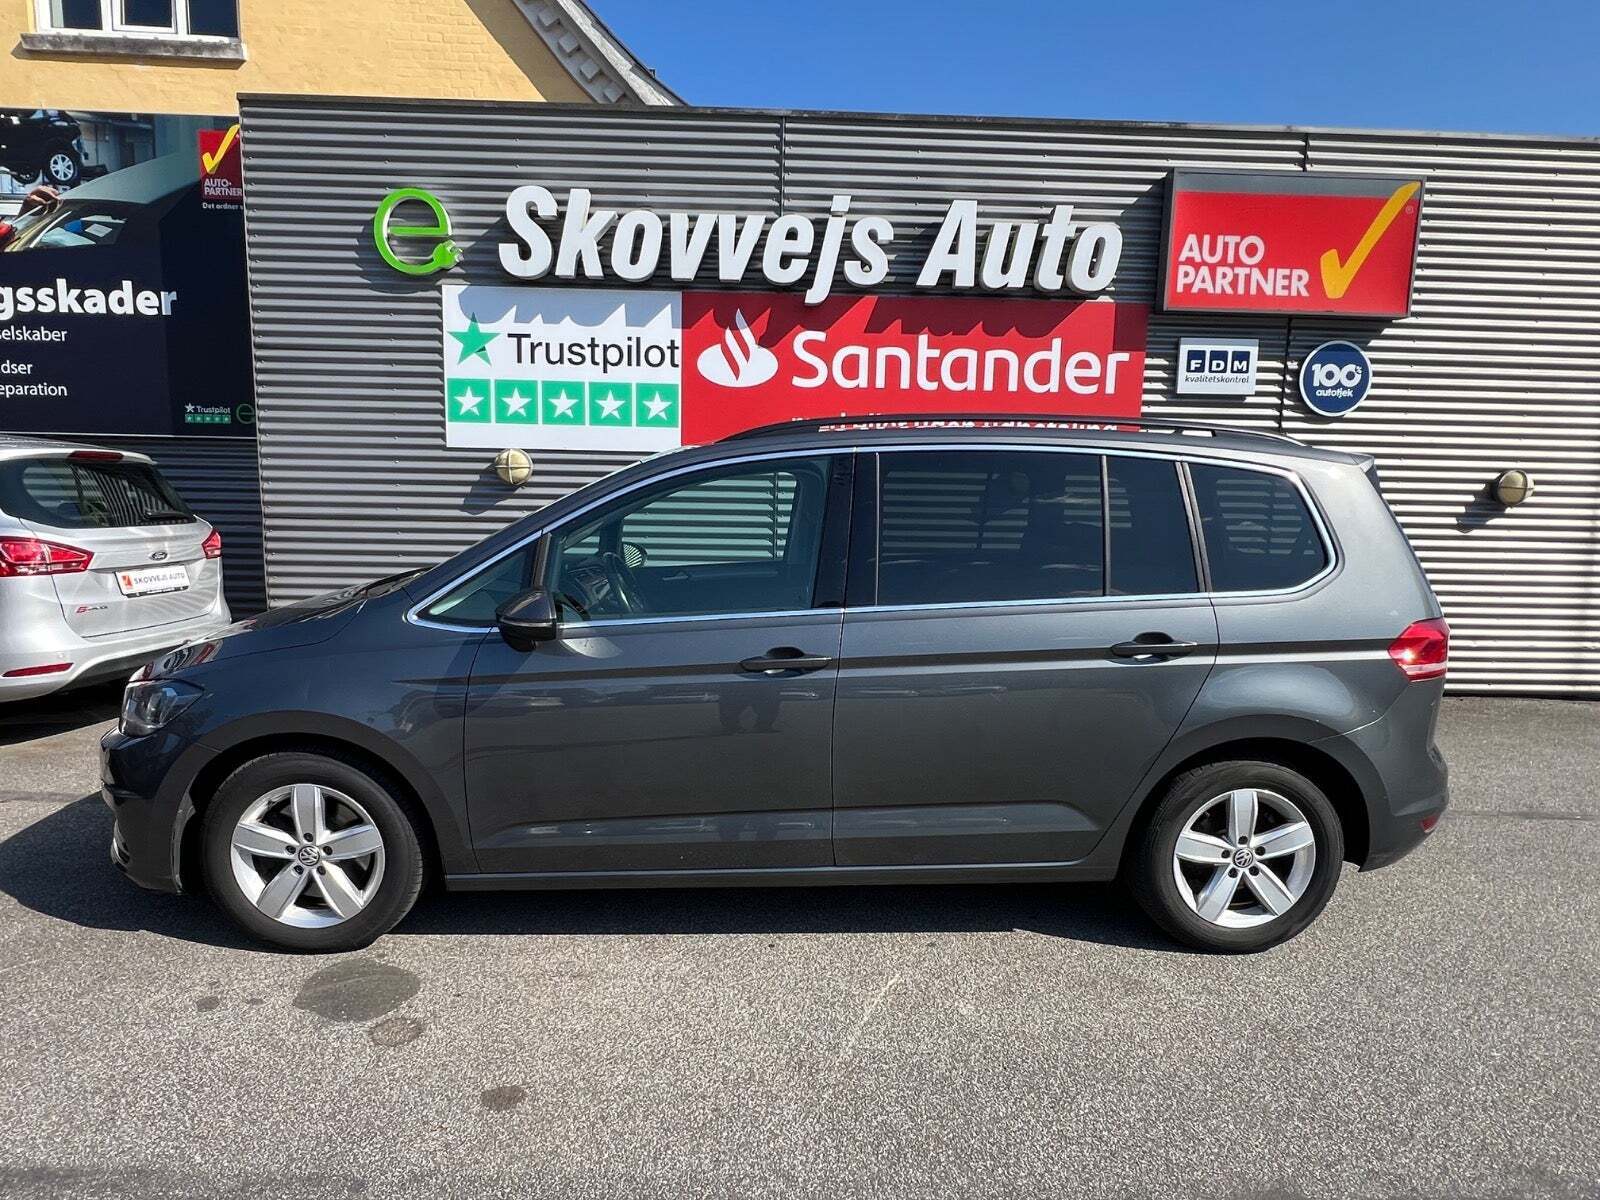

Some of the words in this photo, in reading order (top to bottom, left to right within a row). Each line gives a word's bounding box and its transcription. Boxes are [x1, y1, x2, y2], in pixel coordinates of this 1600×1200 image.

[204, 187, 243, 197] PARTNER
[498, 185, 895, 307] Skovvejs
[914, 199, 1123, 292] Auto
[1178, 233, 1266, 265] AUTO
[1176, 265, 1311, 298] PARTNER
[507, 333, 680, 374] Trustpilot
[792, 329, 1130, 395] Santander
[1184, 374, 1249, 384] kvalitetskontrol
[1315, 388, 1354, 399] autotjek
[196, 405, 231, 414] Trustpilot
